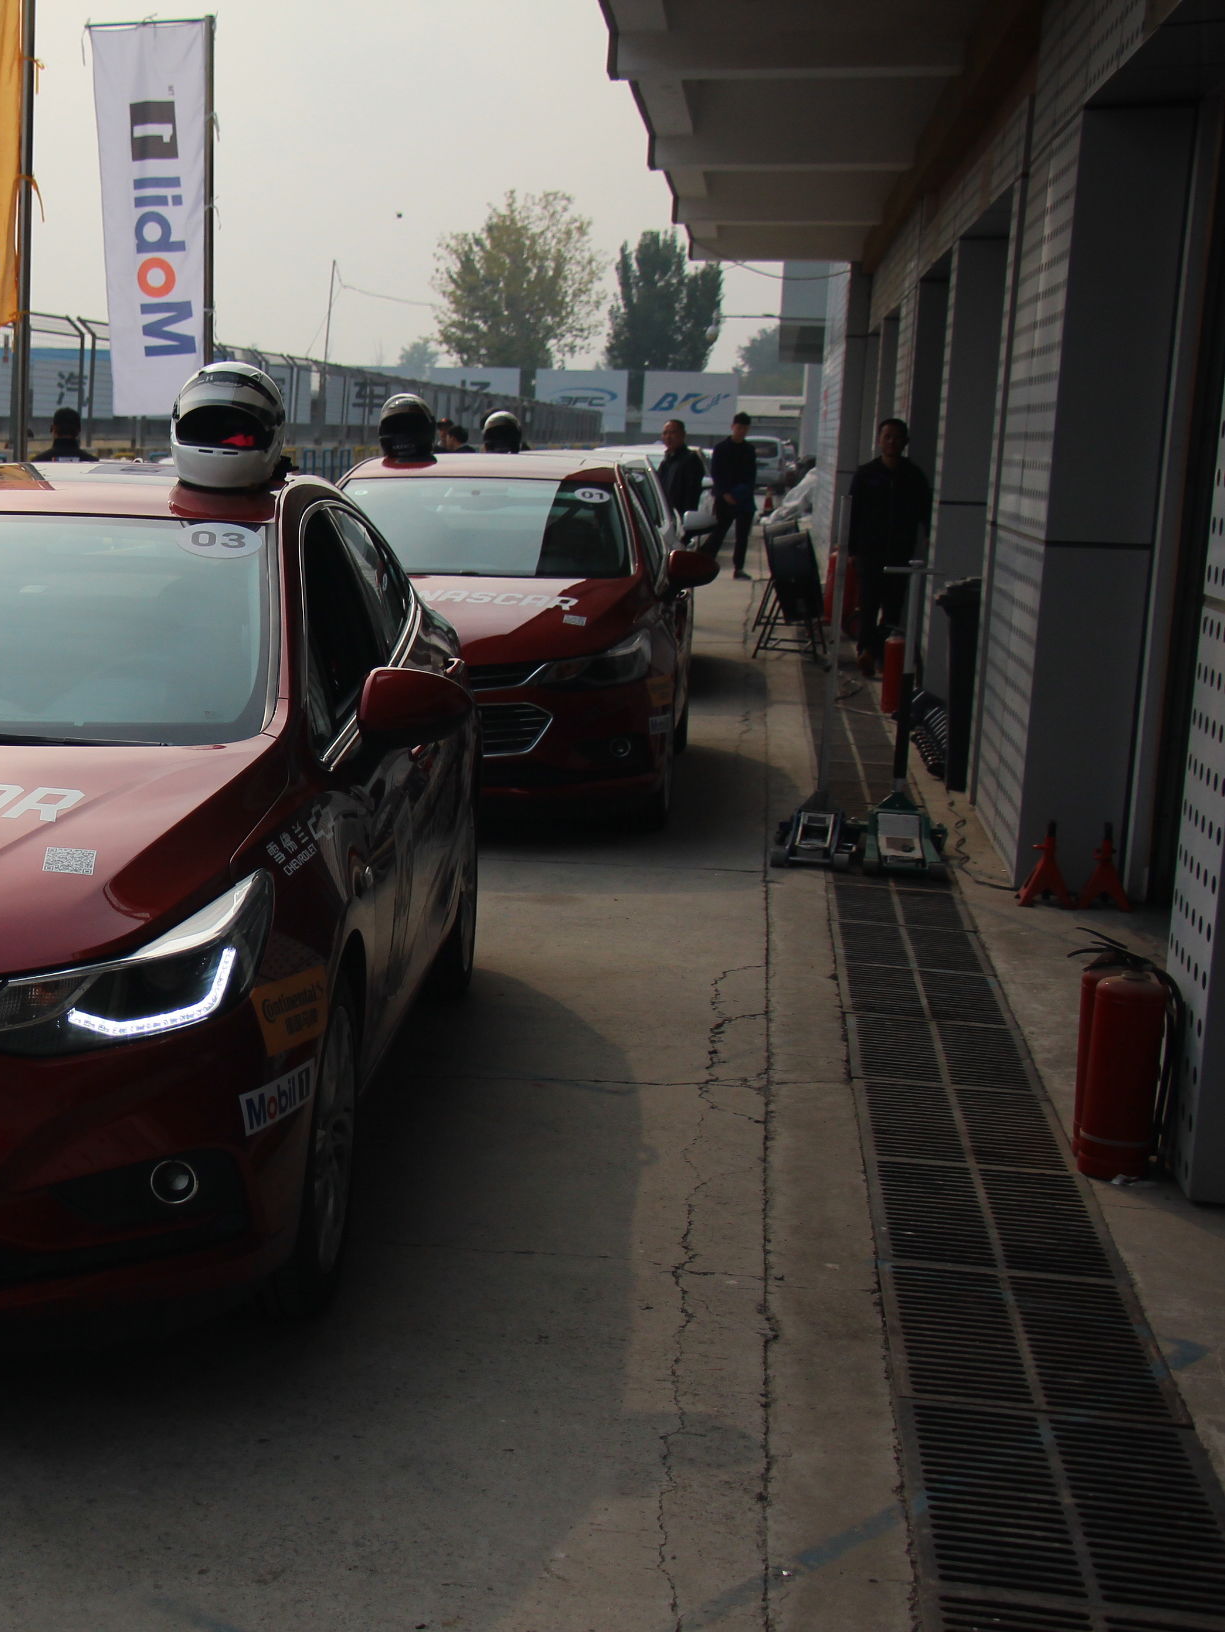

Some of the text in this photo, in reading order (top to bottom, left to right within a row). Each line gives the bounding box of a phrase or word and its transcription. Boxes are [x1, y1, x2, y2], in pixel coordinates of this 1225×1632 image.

[581, 490, 604, 500] 01
[191, 530, 246, 549] 03
[420, 589, 580, 611] NASCAR
[266, 820, 309, 864] 雪佛兰
[283, 843, 317, 876] CHEVROLET
[262, 985, 317, 1023] Continental
[246, 1077, 296, 1130] Mobil
